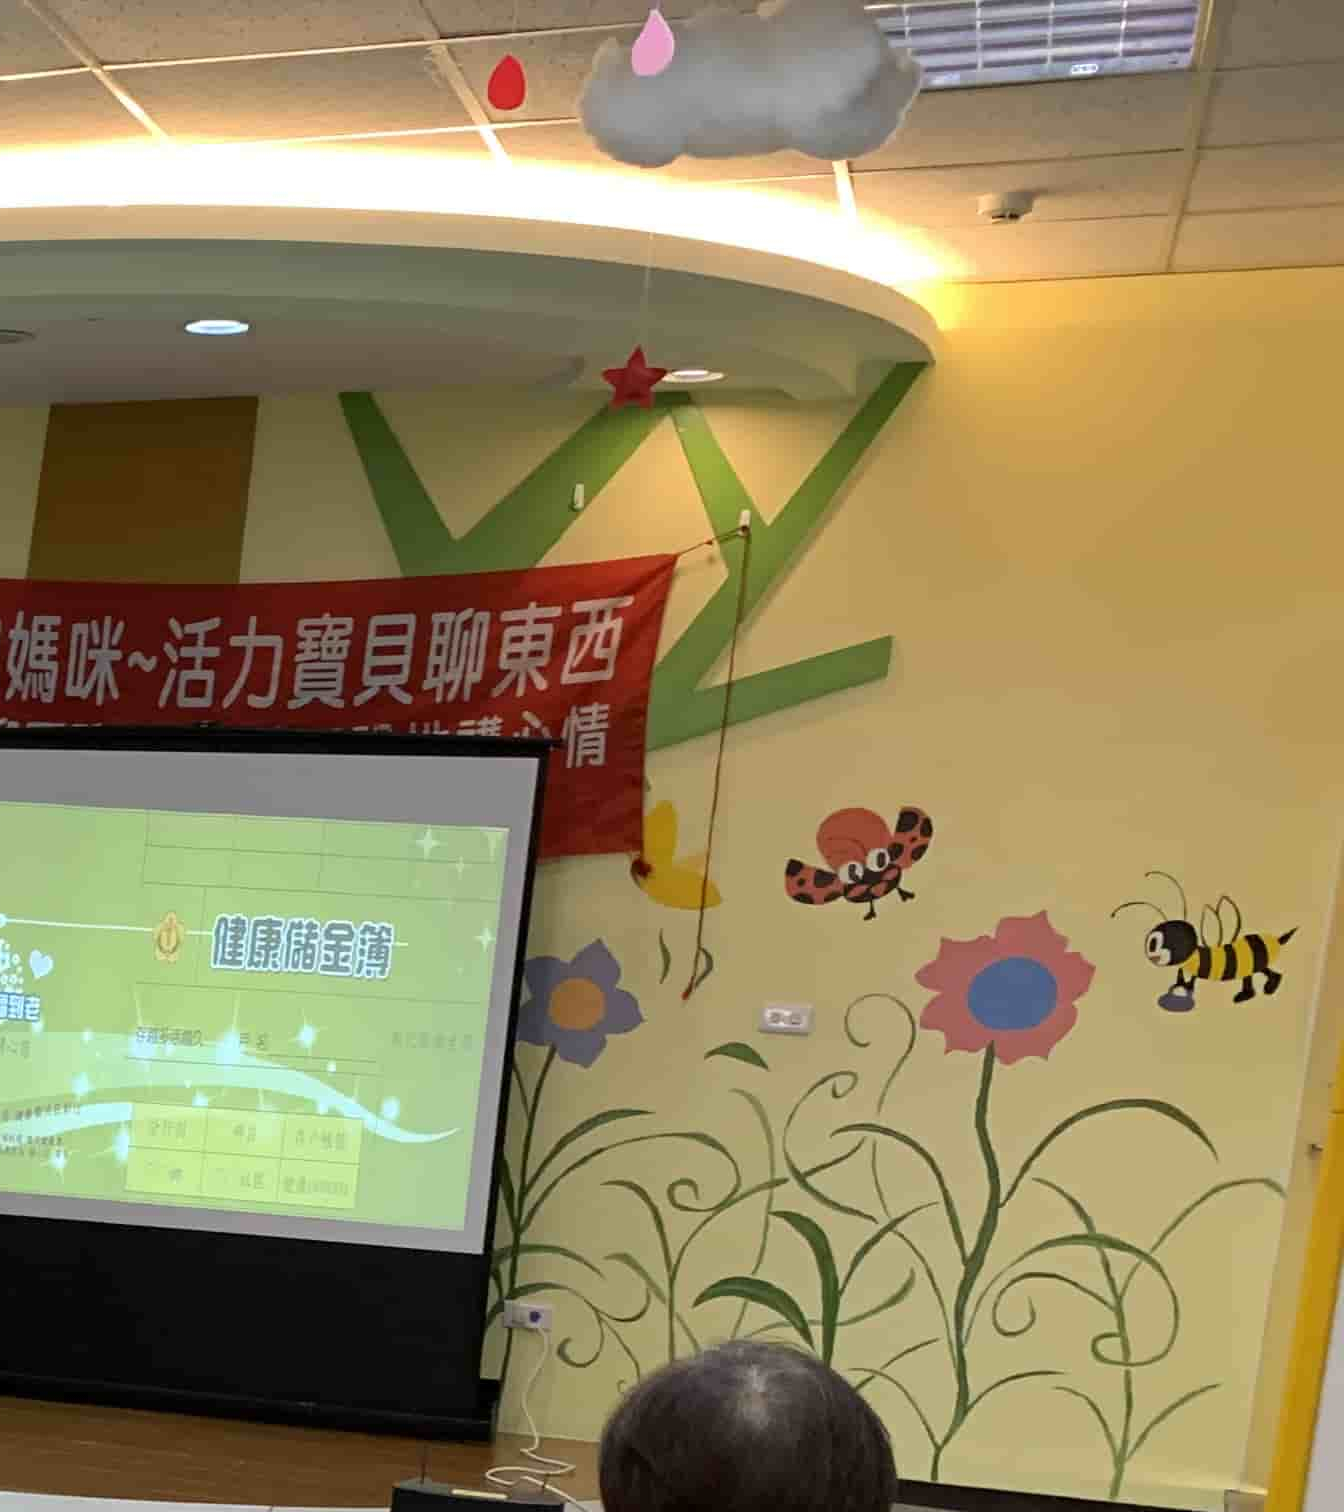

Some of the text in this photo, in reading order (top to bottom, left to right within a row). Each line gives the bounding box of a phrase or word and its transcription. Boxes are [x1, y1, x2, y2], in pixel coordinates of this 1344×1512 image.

[212, 913, 394, 980] 健康儲金簿
